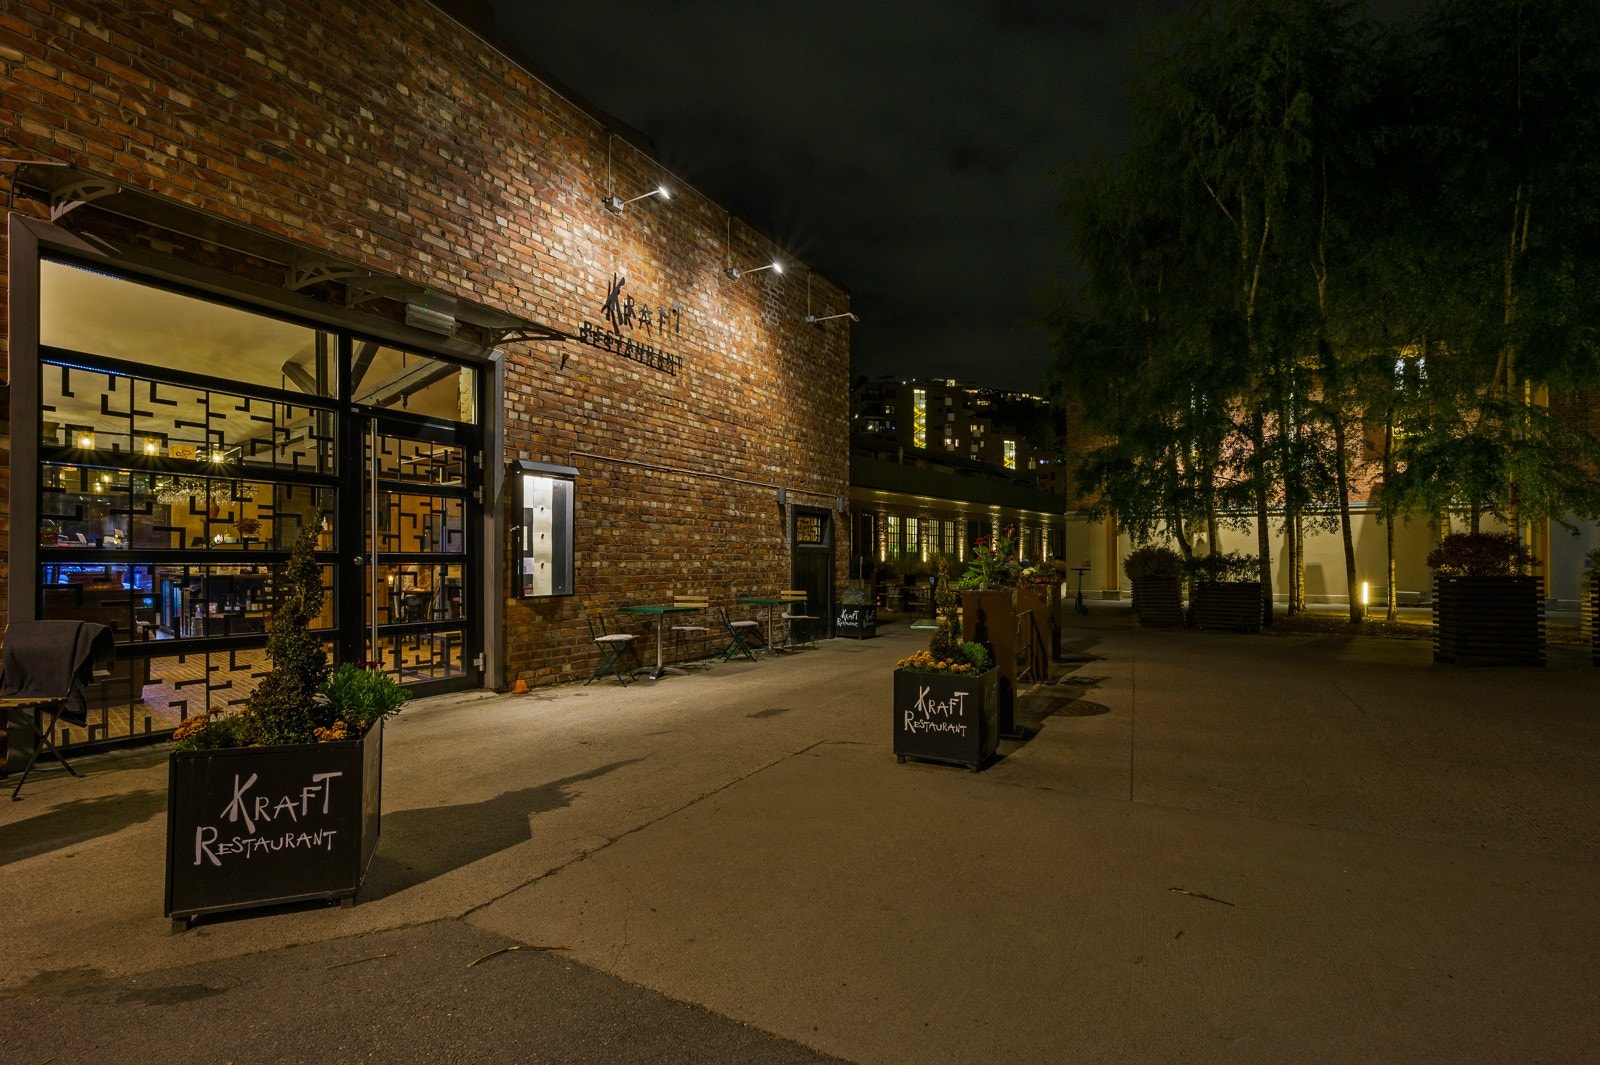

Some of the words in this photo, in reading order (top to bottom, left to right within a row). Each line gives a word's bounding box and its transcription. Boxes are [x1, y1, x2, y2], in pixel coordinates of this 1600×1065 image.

[601, 272, 684, 334] KRAFT
[581, 320, 682, 372] RESTAURANT
[904, 710, 967, 737] RESTAURANT
[914, 686, 969, 720] KRAFT
[220, 772, 343, 834] KRAFT
[193, 826, 337, 866] RESTAURANT
